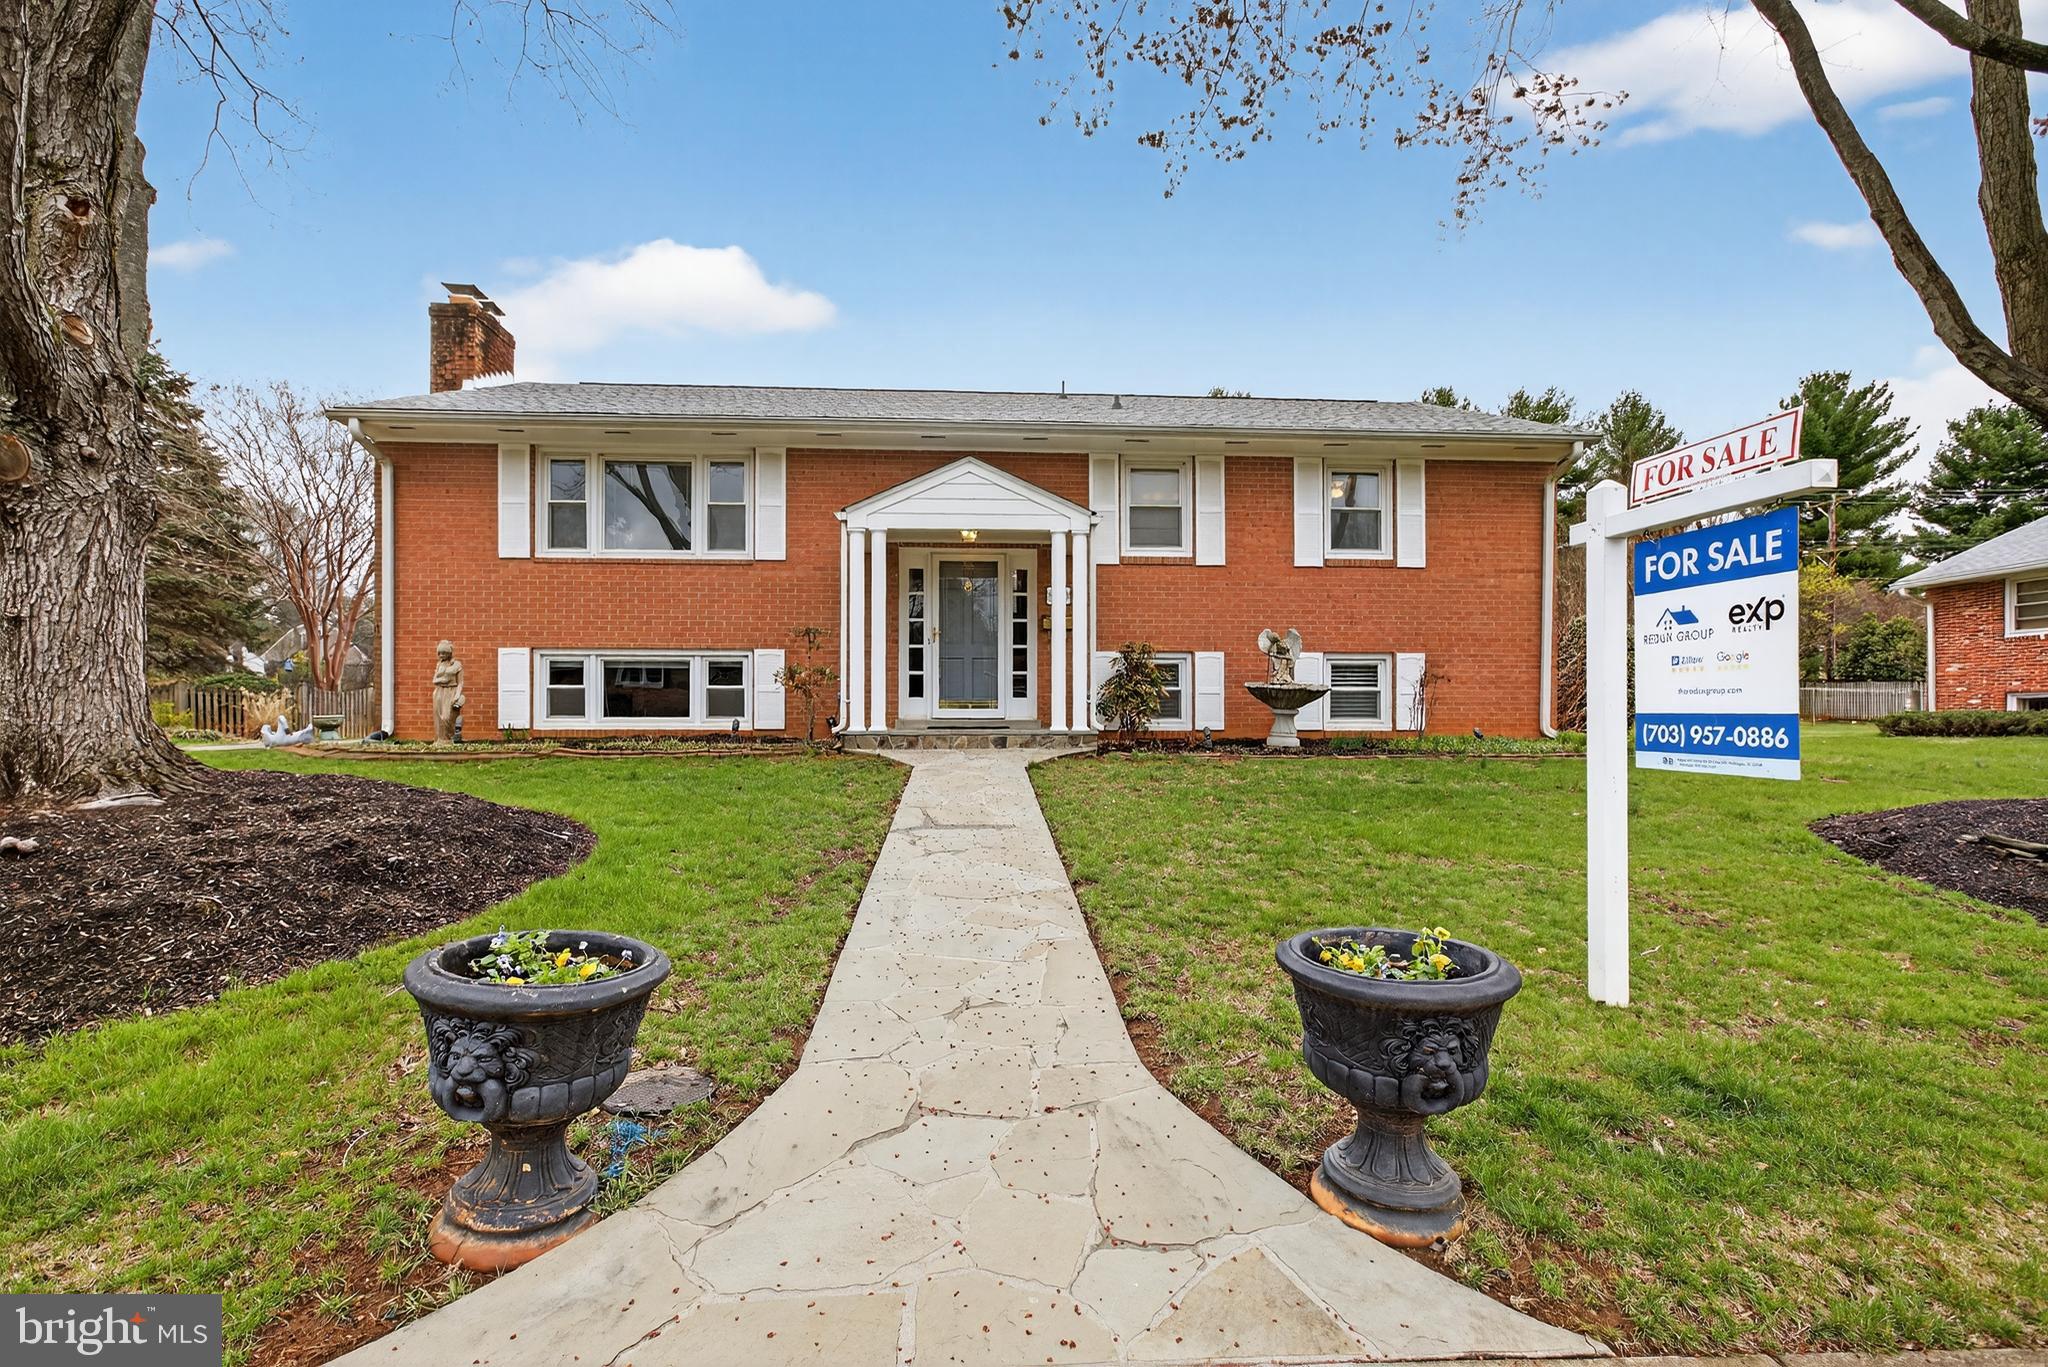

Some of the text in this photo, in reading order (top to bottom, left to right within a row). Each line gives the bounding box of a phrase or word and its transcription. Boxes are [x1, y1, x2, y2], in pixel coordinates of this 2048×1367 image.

[1643, 426, 1778, 493] FOR SALE
[1645, 528, 1782, 583] FOR SALE
[1676, 628, 1715, 642] GROUP
[1642, 723, 1789, 749] (703) 957-0886
